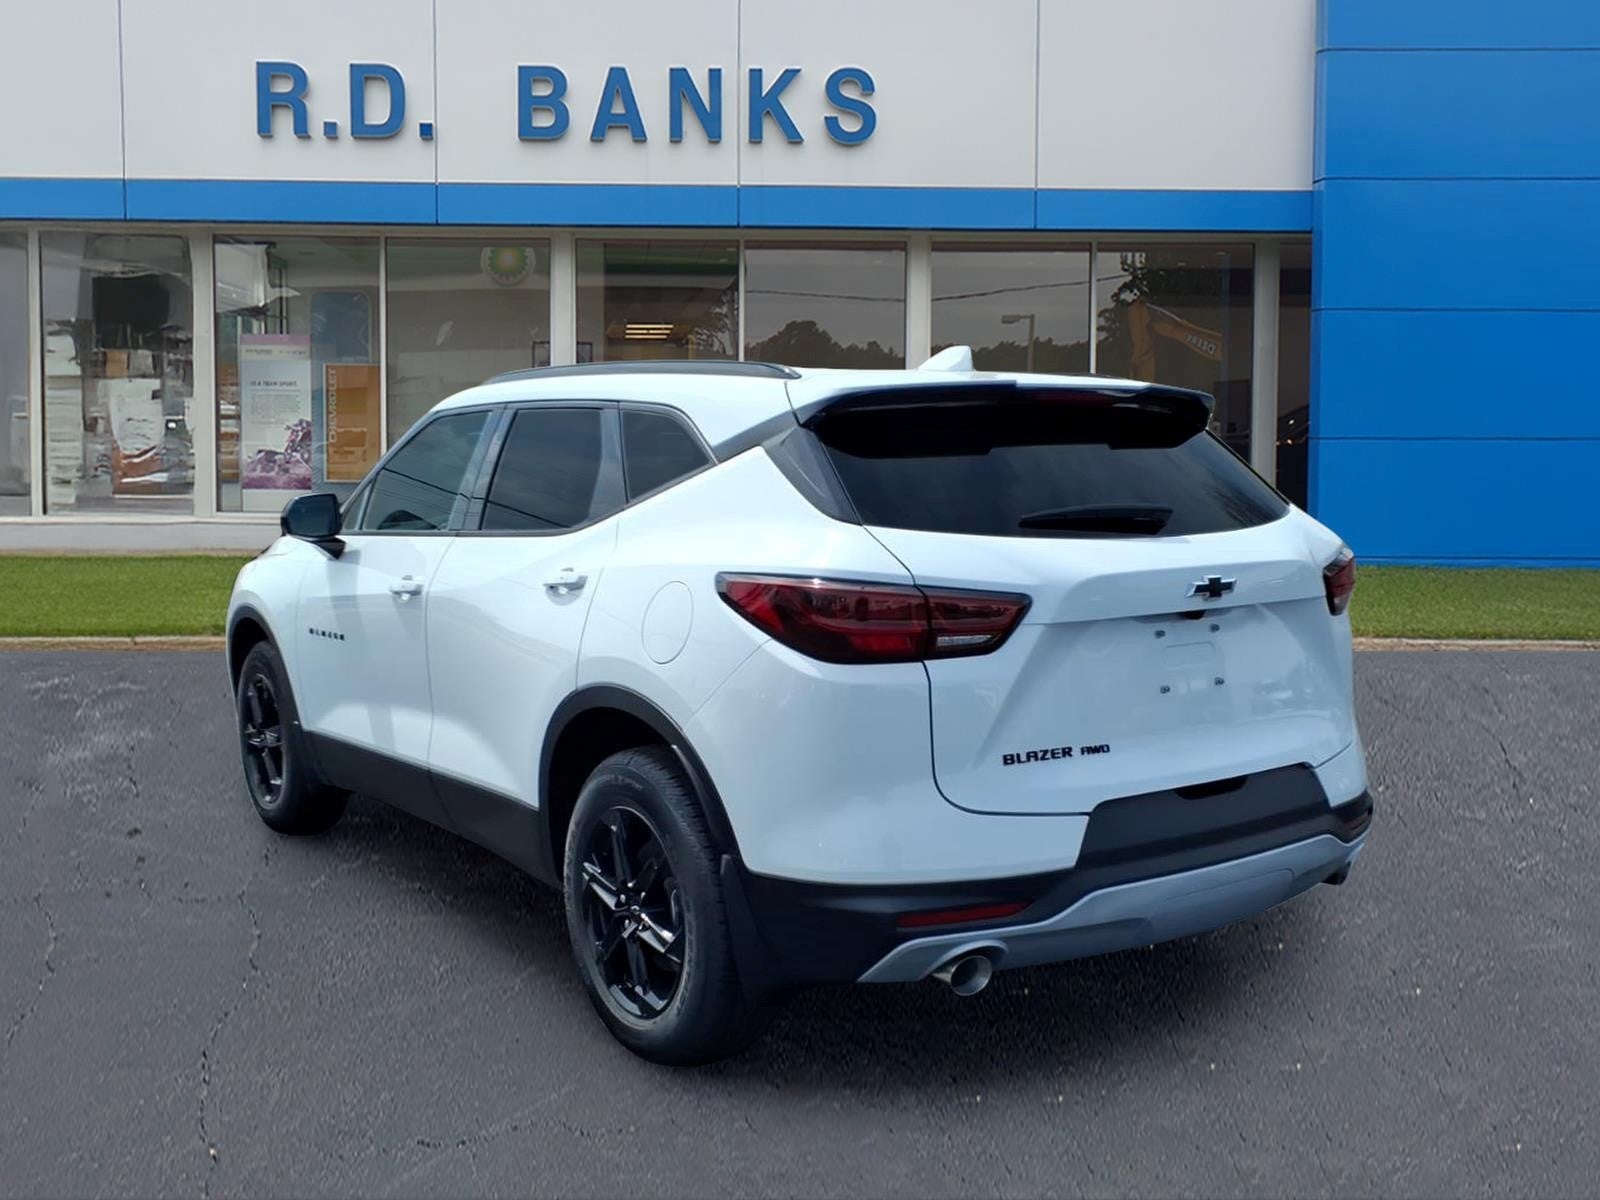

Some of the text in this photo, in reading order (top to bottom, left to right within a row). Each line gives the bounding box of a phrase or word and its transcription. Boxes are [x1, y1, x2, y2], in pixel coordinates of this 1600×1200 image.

[256, 61, 878, 145] R.D. BANKS
[1002, 744, 1111, 766] BLAZER AWD
